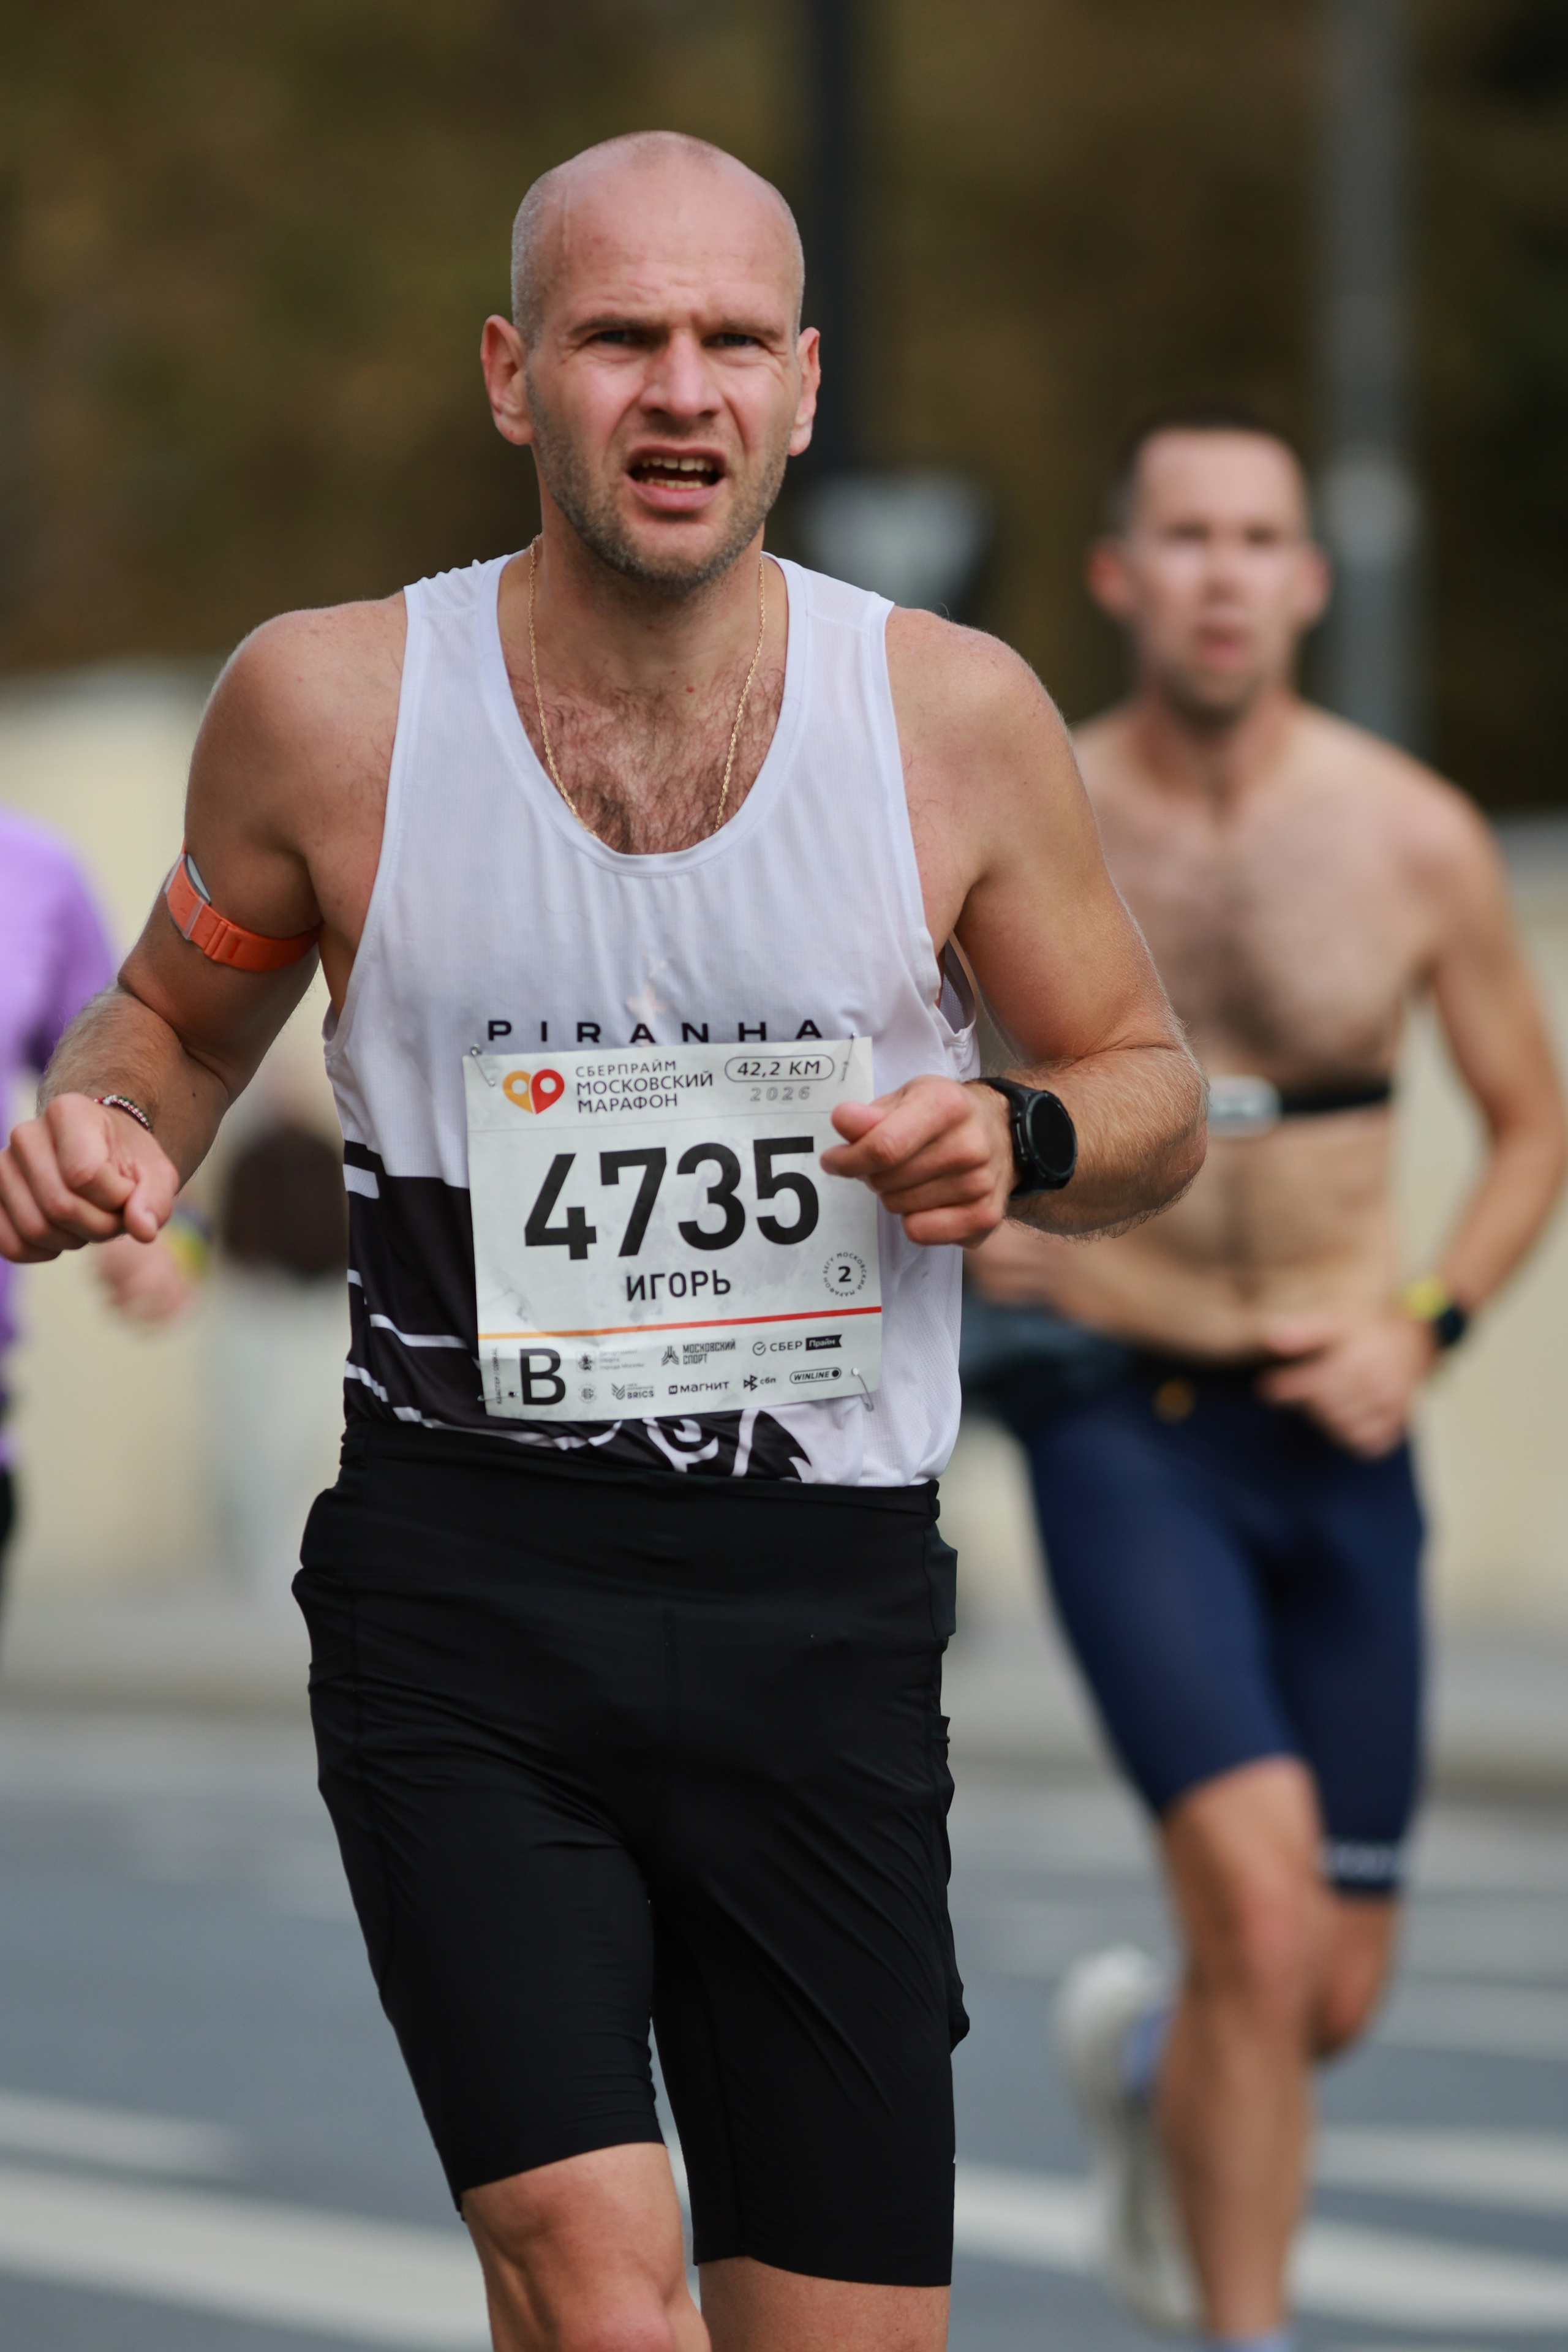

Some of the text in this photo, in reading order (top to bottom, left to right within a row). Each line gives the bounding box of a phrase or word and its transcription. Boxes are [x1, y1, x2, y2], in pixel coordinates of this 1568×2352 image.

[489, 1019, 823, 1043] PIRANHA
[575, 1059, 677, 1077] СБЕРПРАЙМ
[737, 1060, 820, 1078] 42,2 КМ
[576, 1070, 714, 1096] МОСКОВСКИЙ
[750, 1086, 810, 1102] 2026
[578, 1093, 678, 1114] МАРАФОН
[524, 1136, 819, 1261] 4735
[838, 1265, 852, 1283] 2
[625, 1269, 731, 1301] ИГОРЬ
[682, 1338, 736, 1354] МОСКОВСКИЙ
[769, 1341, 803, 1352] СБЕР
[682, 1353, 707, 1365] СПОРТ
[793, 1371, 830, 1381] WINLINE
[627, 1390, 654, 1399] BRICS
